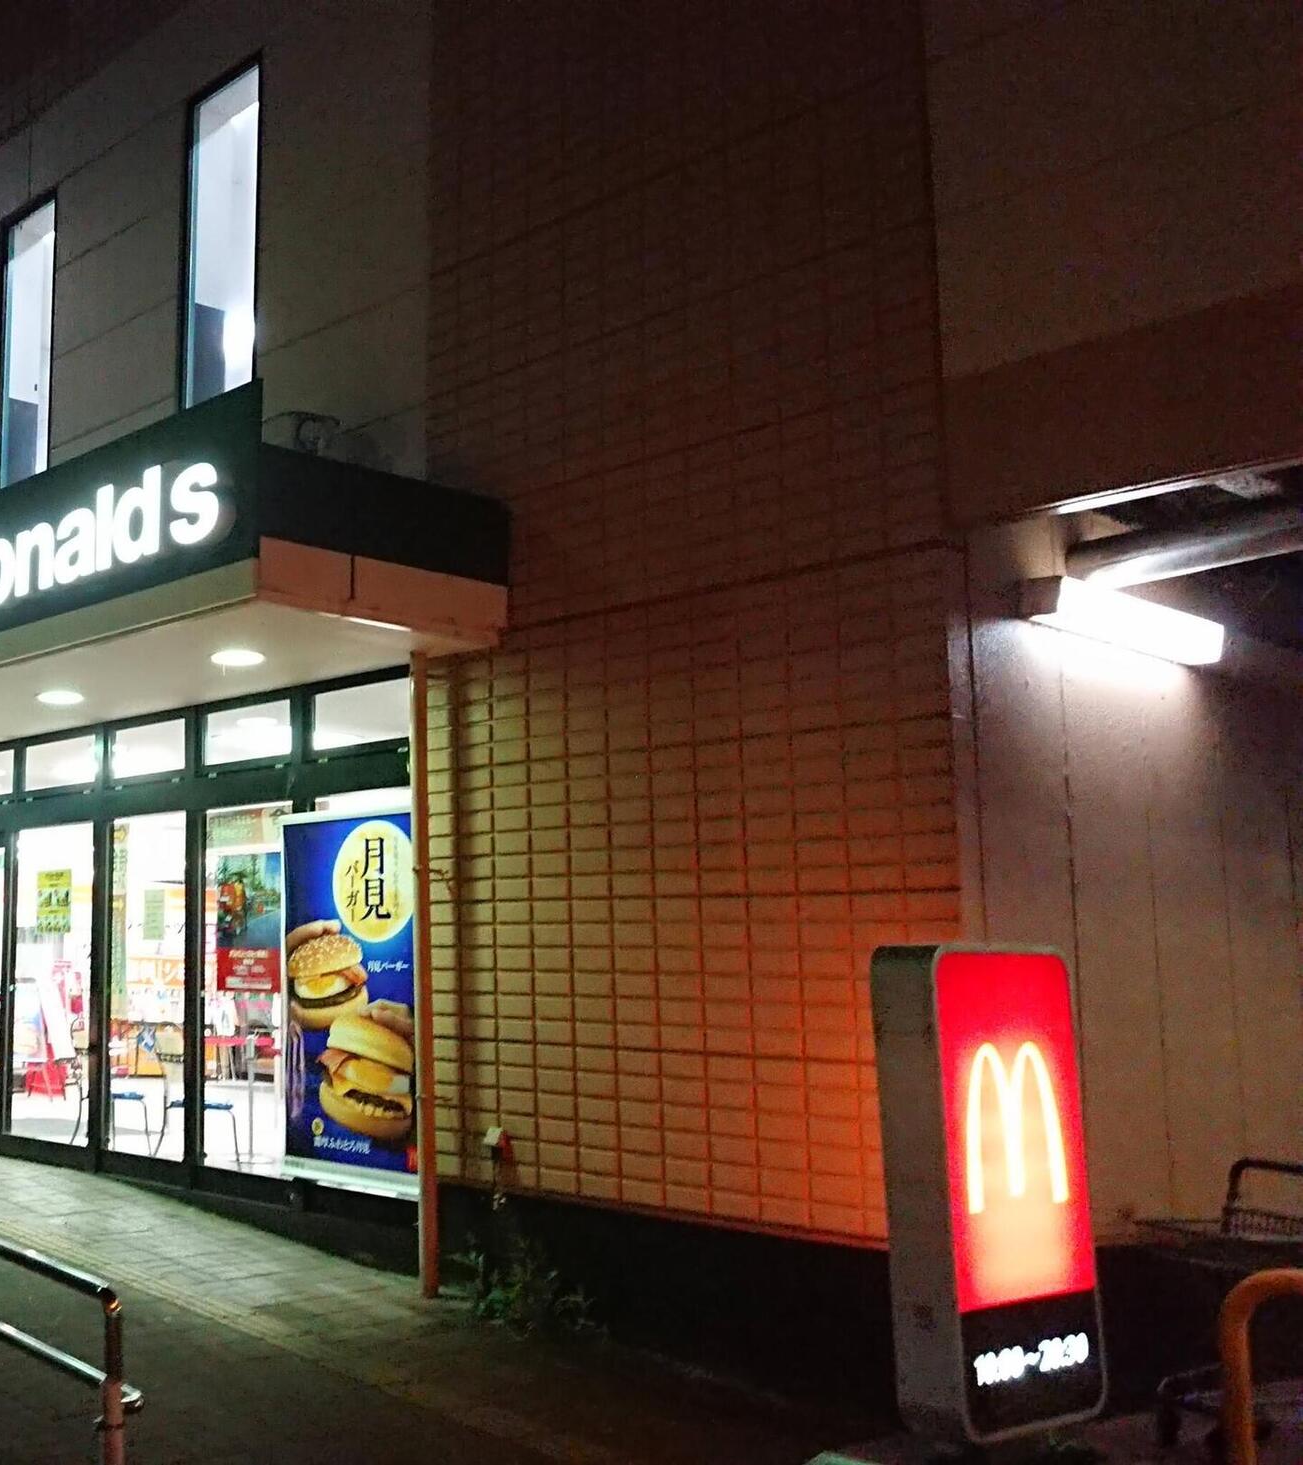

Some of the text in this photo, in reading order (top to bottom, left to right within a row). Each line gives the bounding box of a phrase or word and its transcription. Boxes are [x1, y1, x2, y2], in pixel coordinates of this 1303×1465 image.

[345, 859, 360, 923] バーガー
[360, 836, 392, 922] 月見
